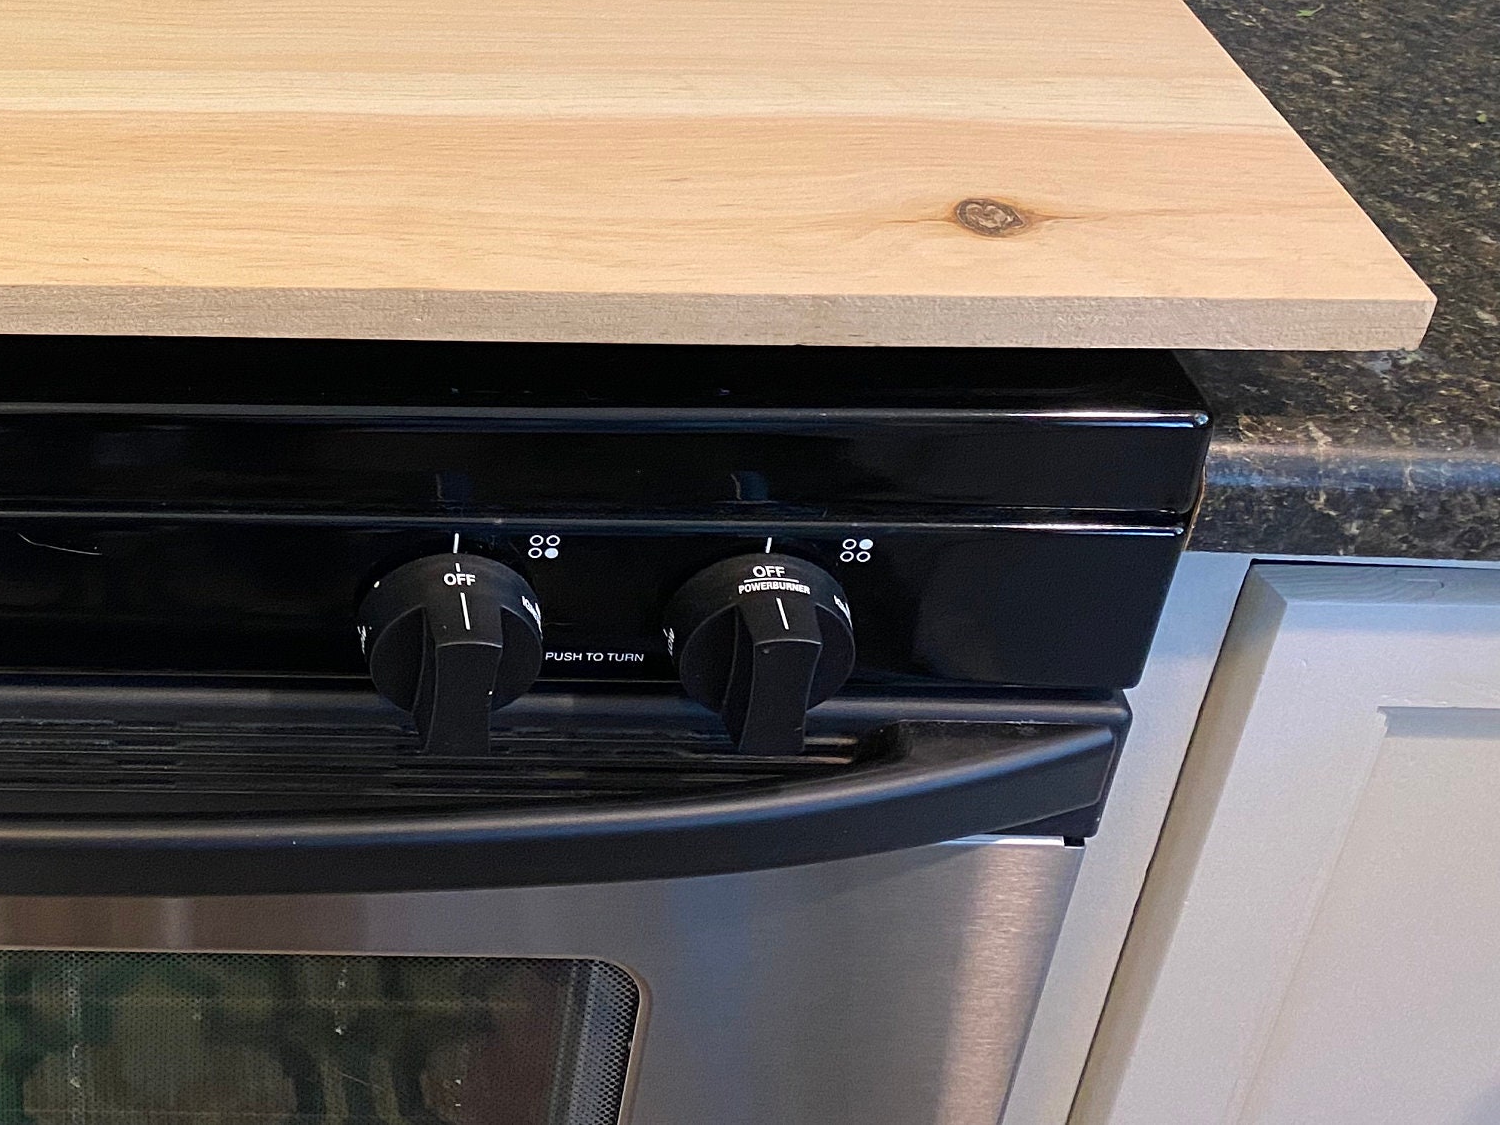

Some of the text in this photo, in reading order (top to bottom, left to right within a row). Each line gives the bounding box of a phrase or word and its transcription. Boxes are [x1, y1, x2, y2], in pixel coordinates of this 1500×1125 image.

[753, 565, 785, 578] OFF
[443, 573, 475, 586] OFF
[738, 581, 810, 595] POWERBURNER
[545, 651, 644, 663] PUSH TO TURN
